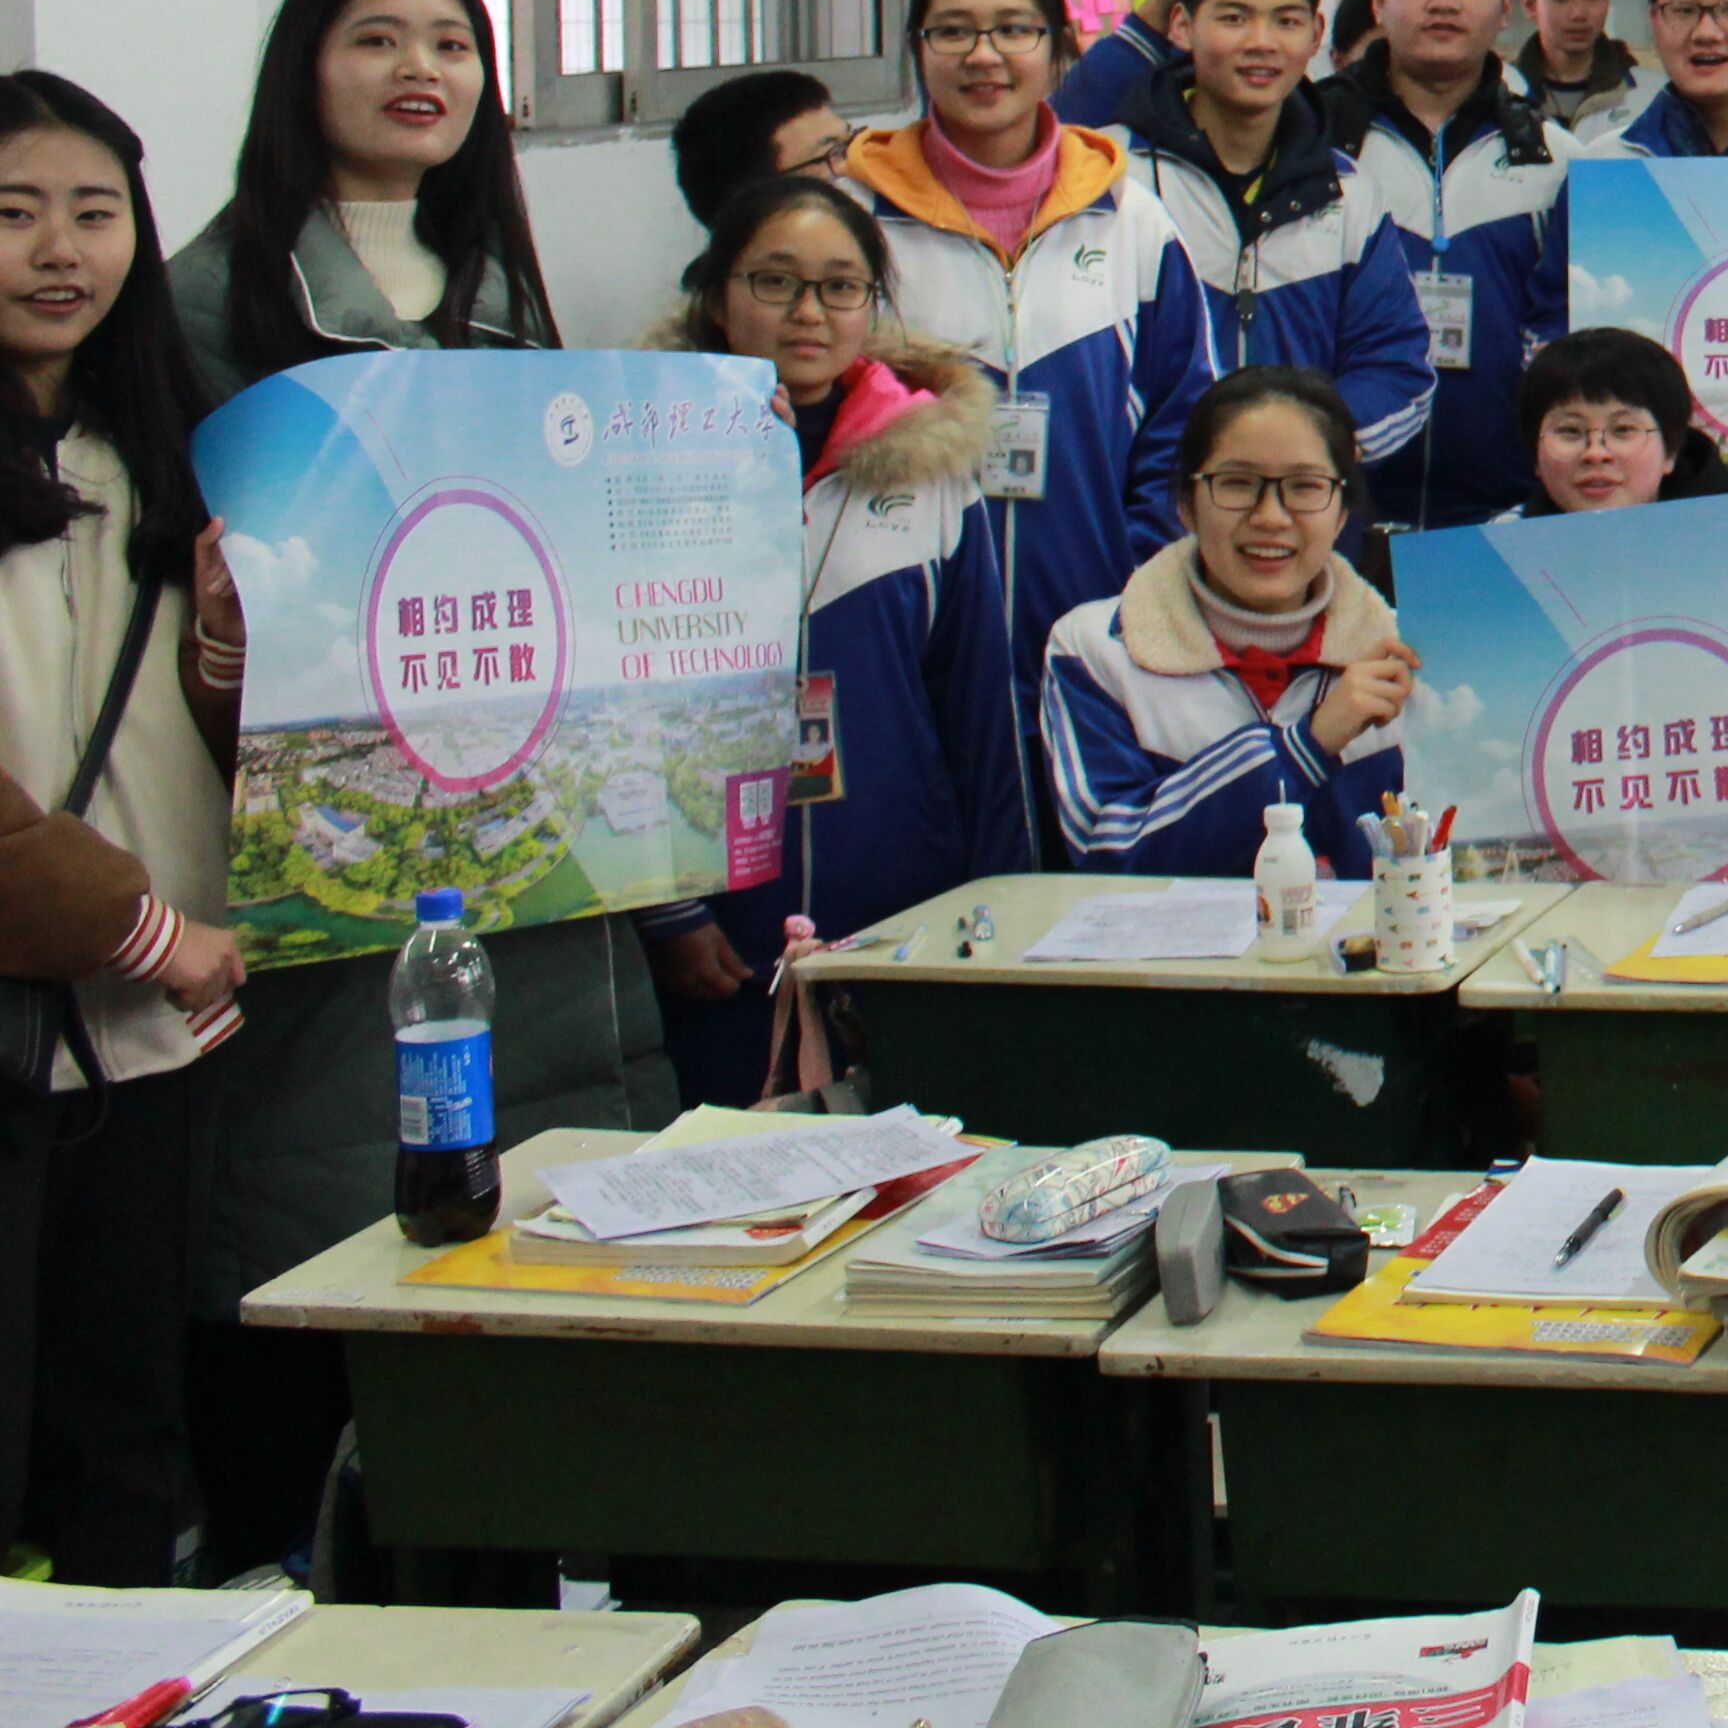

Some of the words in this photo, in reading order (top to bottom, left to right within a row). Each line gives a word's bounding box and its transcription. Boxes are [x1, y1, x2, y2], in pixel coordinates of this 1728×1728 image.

[602, 395, 778, 449] 成都理工大学
[396, 588, 535, 637] 相约成理
[614, 575, 725, 610] CHENGDU
[616, 609, 750, 646] UNIVERSITY
[399, 643, 538, 695] 不见不散
[621, 649, 656, 681] OF
[667, 641, 787, 676] TECHNOLOGY
